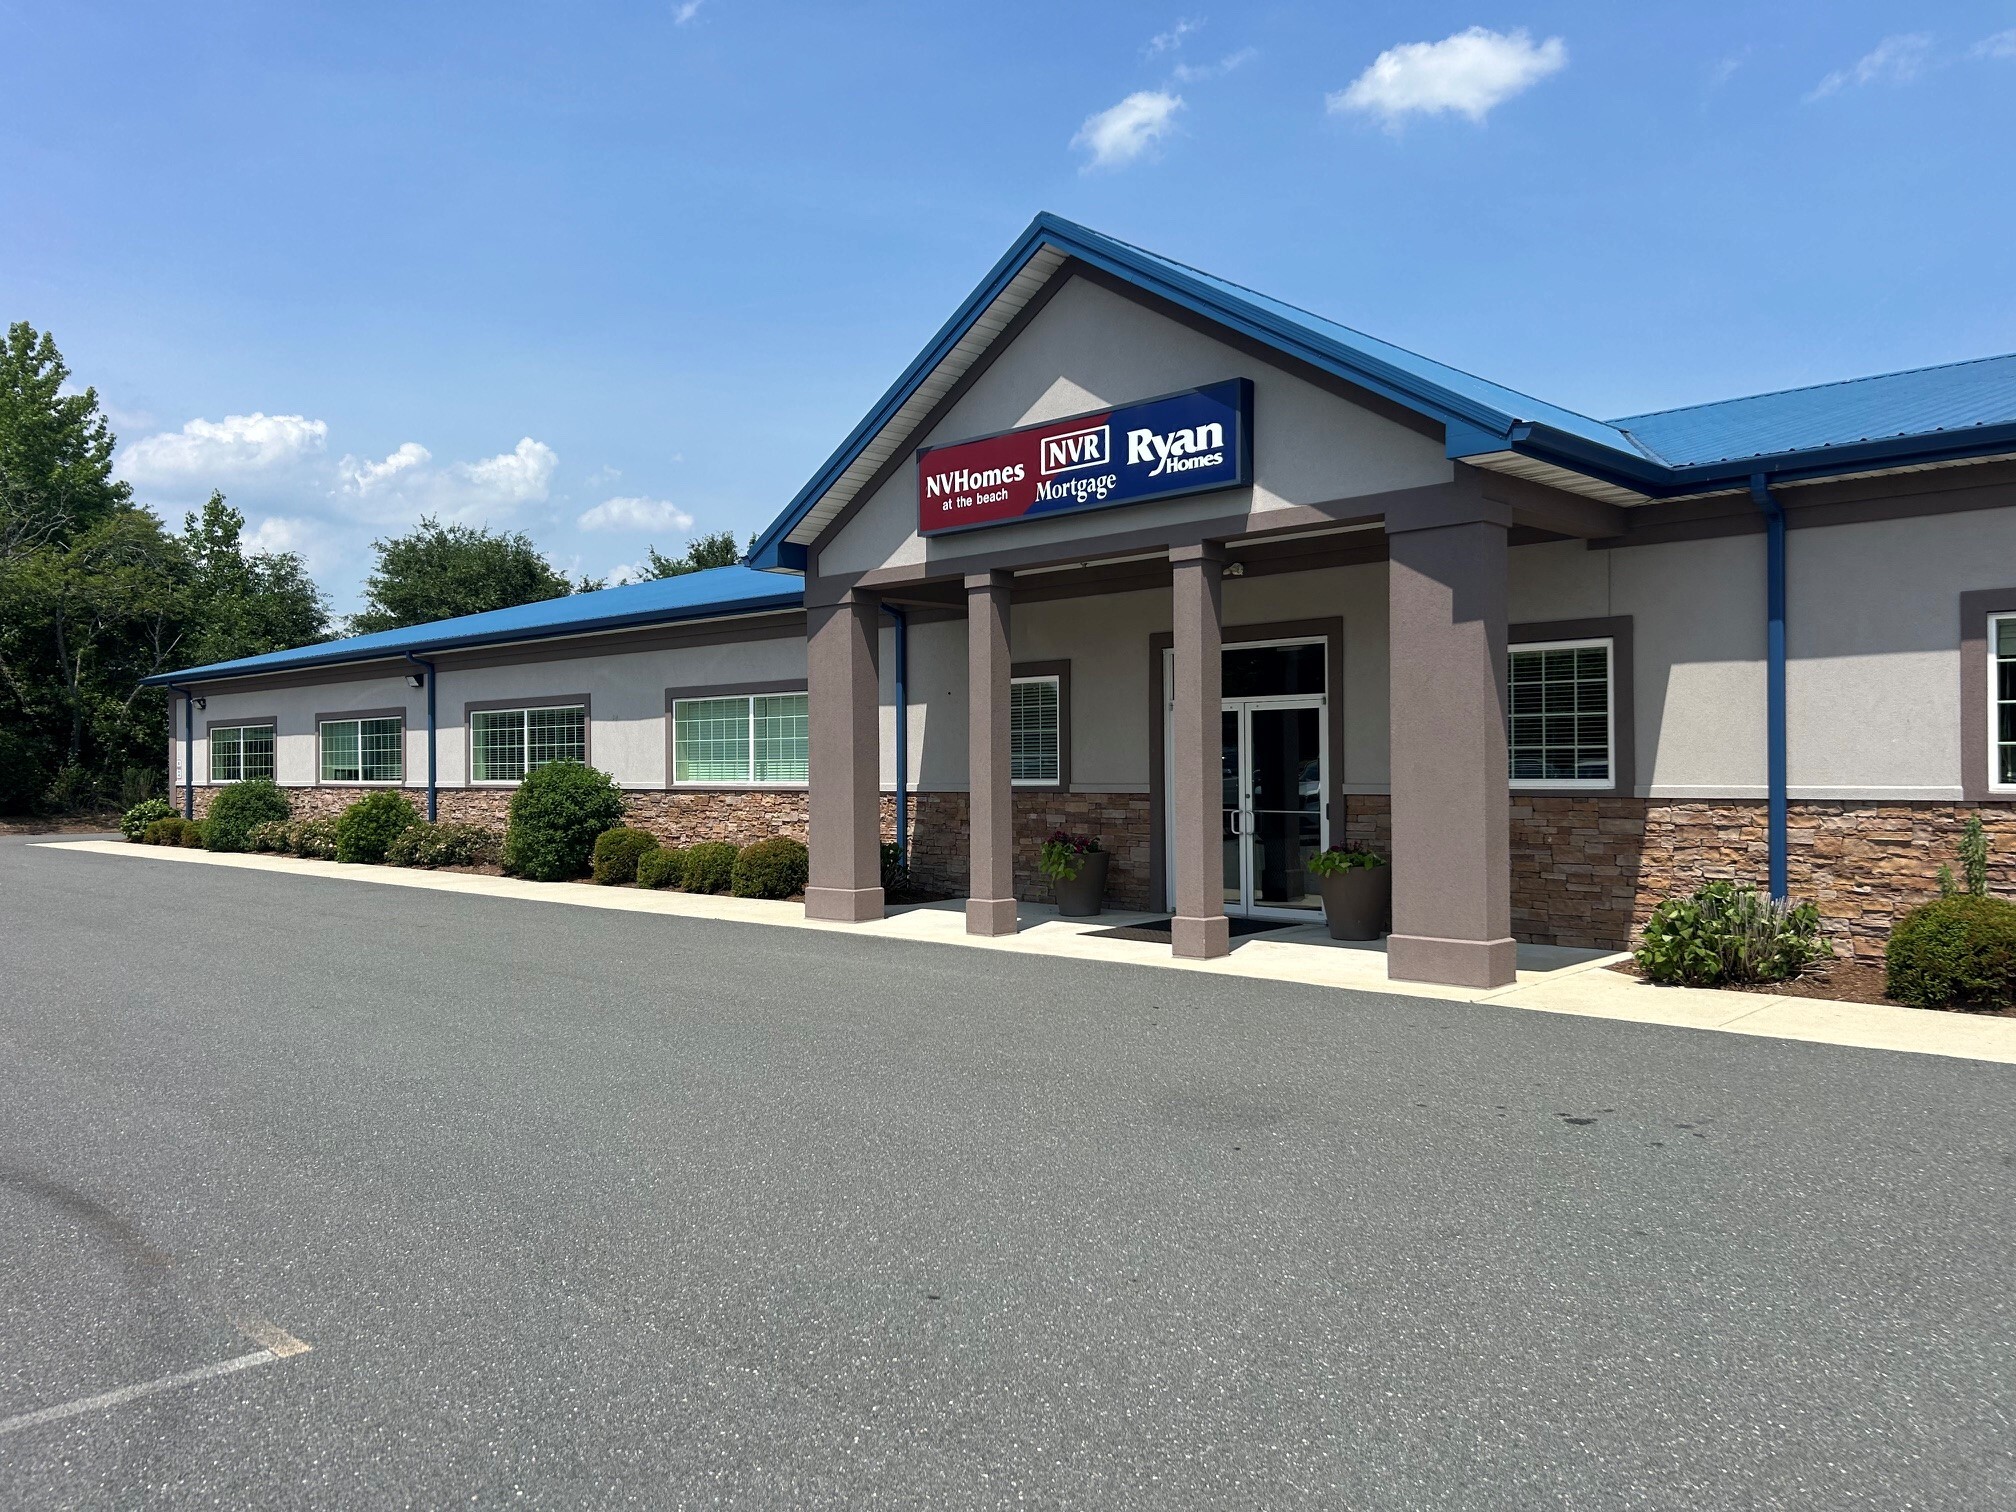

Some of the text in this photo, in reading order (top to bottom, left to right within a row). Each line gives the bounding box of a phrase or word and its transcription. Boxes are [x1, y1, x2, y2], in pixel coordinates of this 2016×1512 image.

[1048, 434, 1101, 468] NVR
[1126, 422, 1224, 477] Ryan
[1166, 452, 1224, 475] Homes
[926, 463, 1025, 498] NVHomes
[1035, 473, 1117, 503] Mortgage
[942, 488, 1008, 511] at the beach
